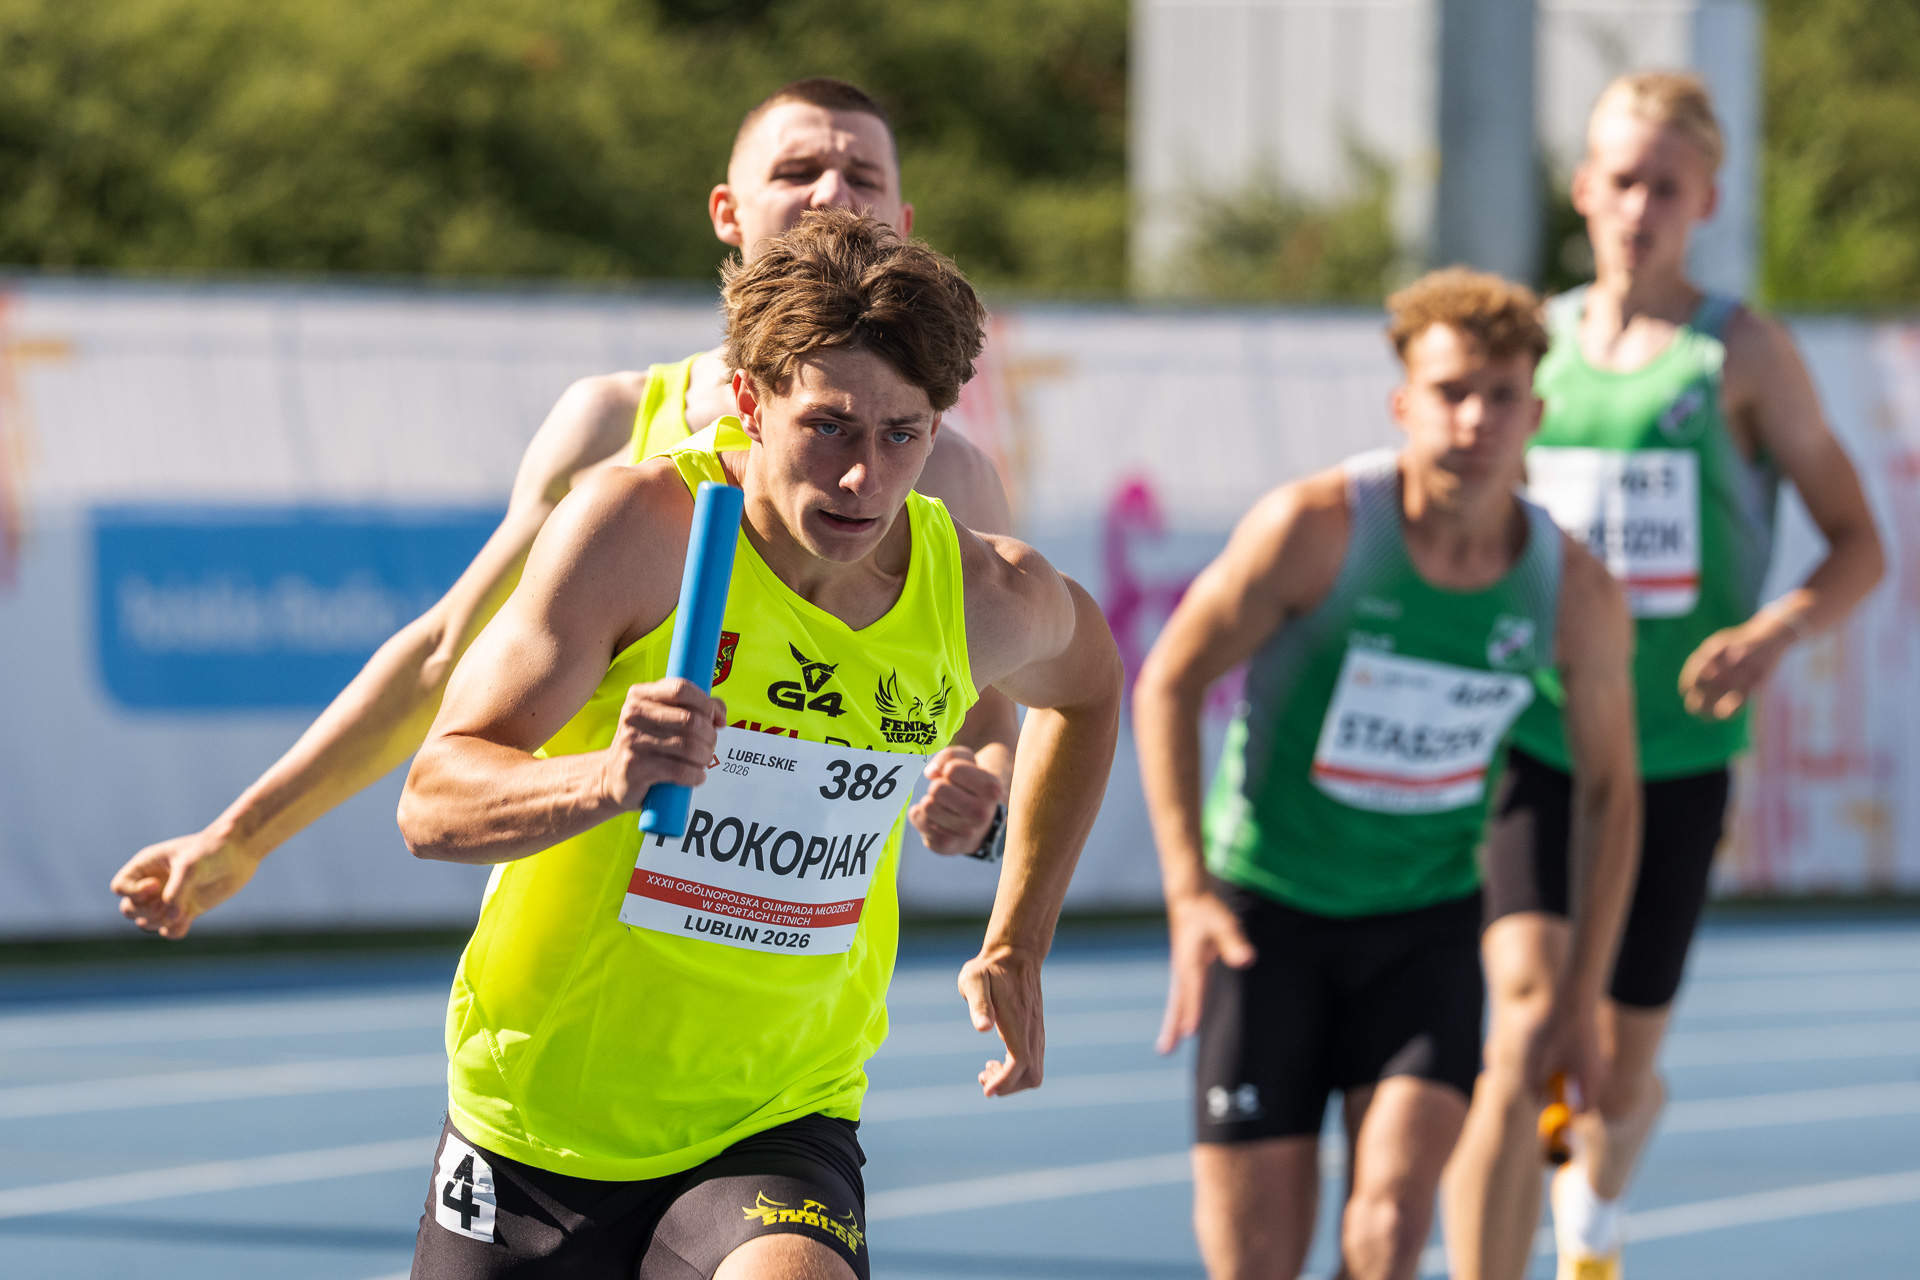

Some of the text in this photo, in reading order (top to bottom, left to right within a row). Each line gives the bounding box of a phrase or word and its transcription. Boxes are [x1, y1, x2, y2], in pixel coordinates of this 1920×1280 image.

[767, 680, 847, 718] G4
[722, 762, 750, 777] 2026
[727, 748, 798, 772] LUBELSKIE
[819, 759, 904, 802] 386
[655, 808, 881, 881] ROKOPIAK
[646, 874, 855, 916] XXXII OGÓLNOPOLSKA OLIMPIADA MŁODZIEŻY
[702, 900, 812, 926] W SPORTACH LETNICH
[683, 914, 811, 949] LUBLIN 2026
